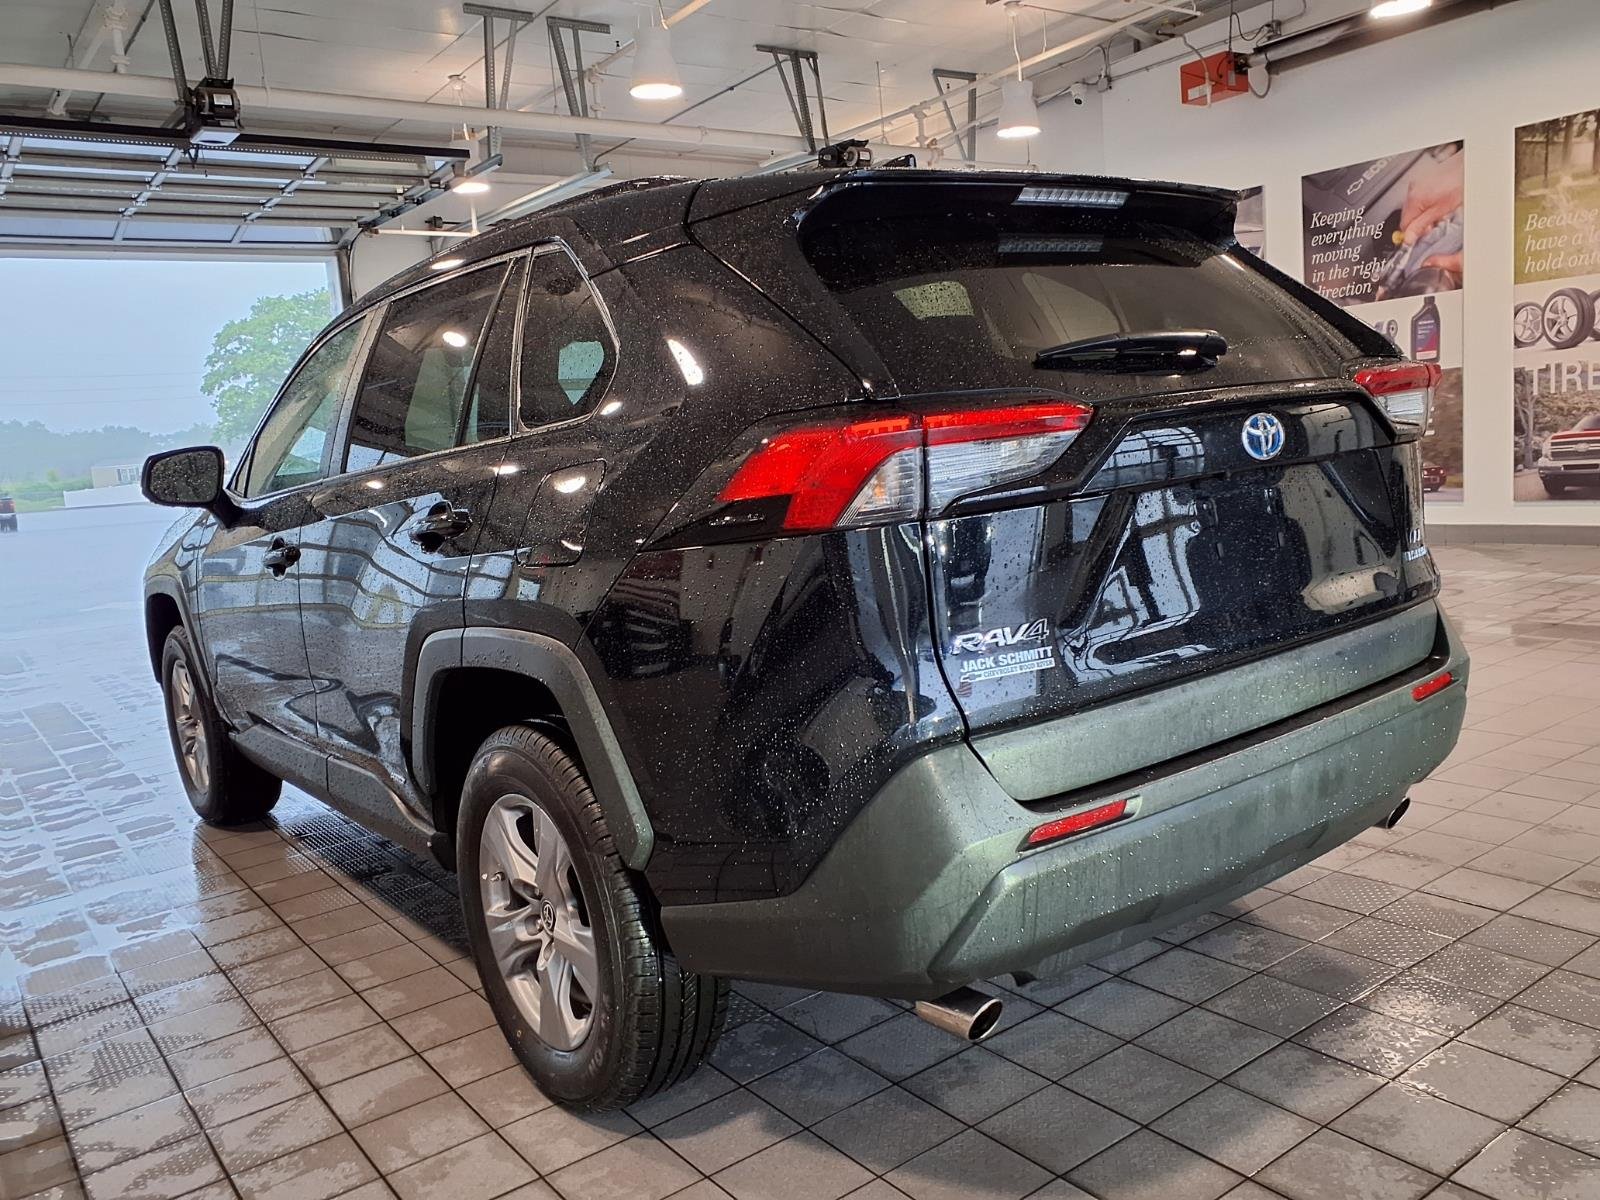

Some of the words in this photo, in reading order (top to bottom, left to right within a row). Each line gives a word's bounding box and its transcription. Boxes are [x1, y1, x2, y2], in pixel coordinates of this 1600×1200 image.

[1310, 205, 1365, 229] Keeping
[1524, 208, 1599, 231] Because
[1311, 219, 1385, 246] everything
[1525, 234, 1568, 252] have
[1572, 233, 1582, 245] a
[1311, 244, 1362, 265] moving
[1524, 251, 1564, 274] hold
[1312, 269, 1326, 283] in
[1328, 263, 1350, 280] the
[1352, 257, 1387, 279] right
[951, 618, 1050, 655] RAV4
[960, 656, 996, 673] JACK
[998, 646, 1053, 666] SCHMITT
